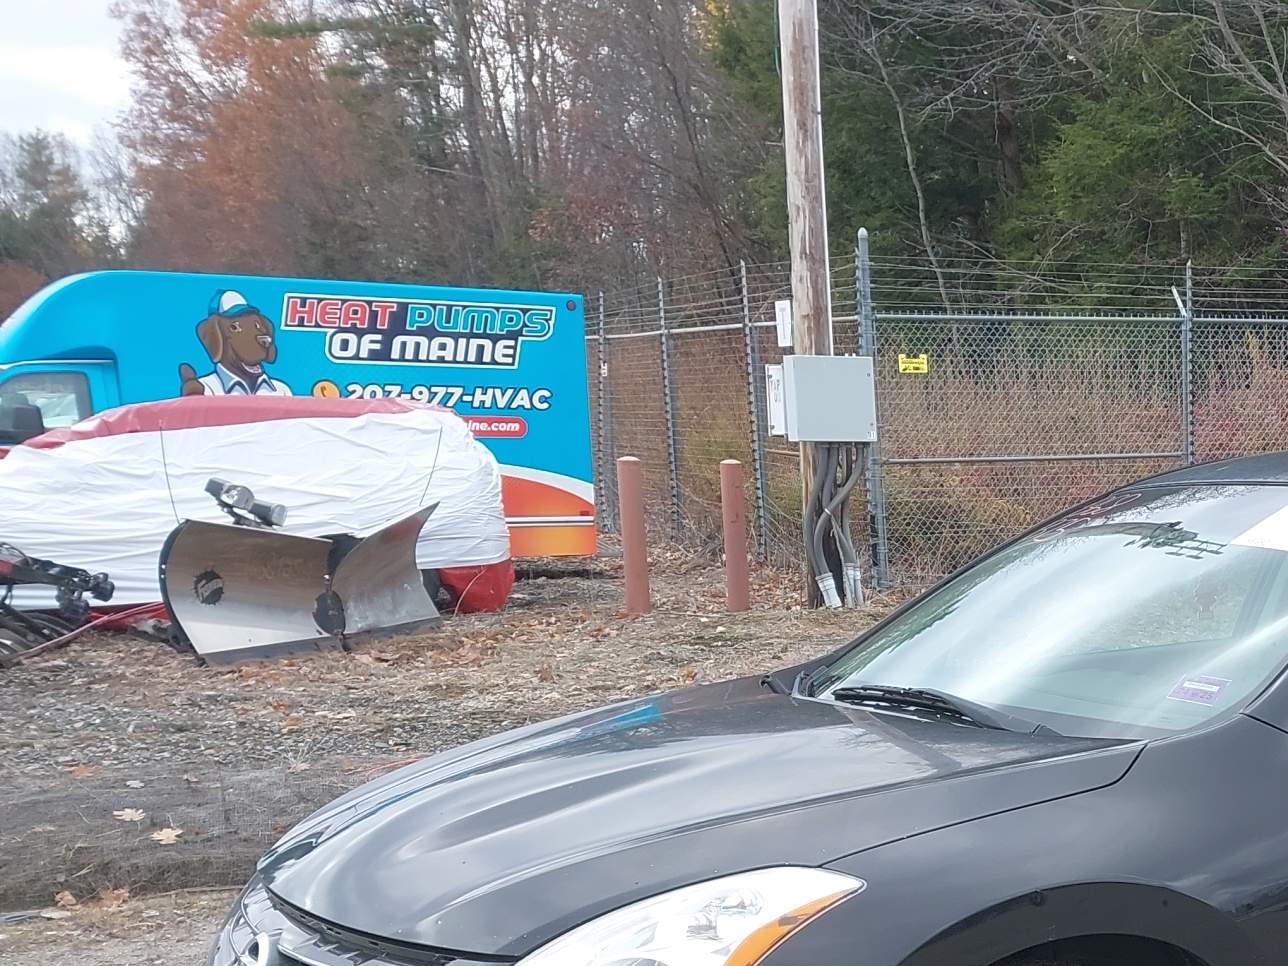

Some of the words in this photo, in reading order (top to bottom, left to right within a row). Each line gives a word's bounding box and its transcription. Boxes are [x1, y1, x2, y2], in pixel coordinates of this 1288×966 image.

[287, 298, 398, 329] HEAT
[406, 303, 551, 336] PUMPS
[330, 332, 381, 359] OF
[390, 335, 517, 364] MAINE
[346, 384, 551, 410] 207-977-HVAC
[466, 420, 520, 432] ine.com
